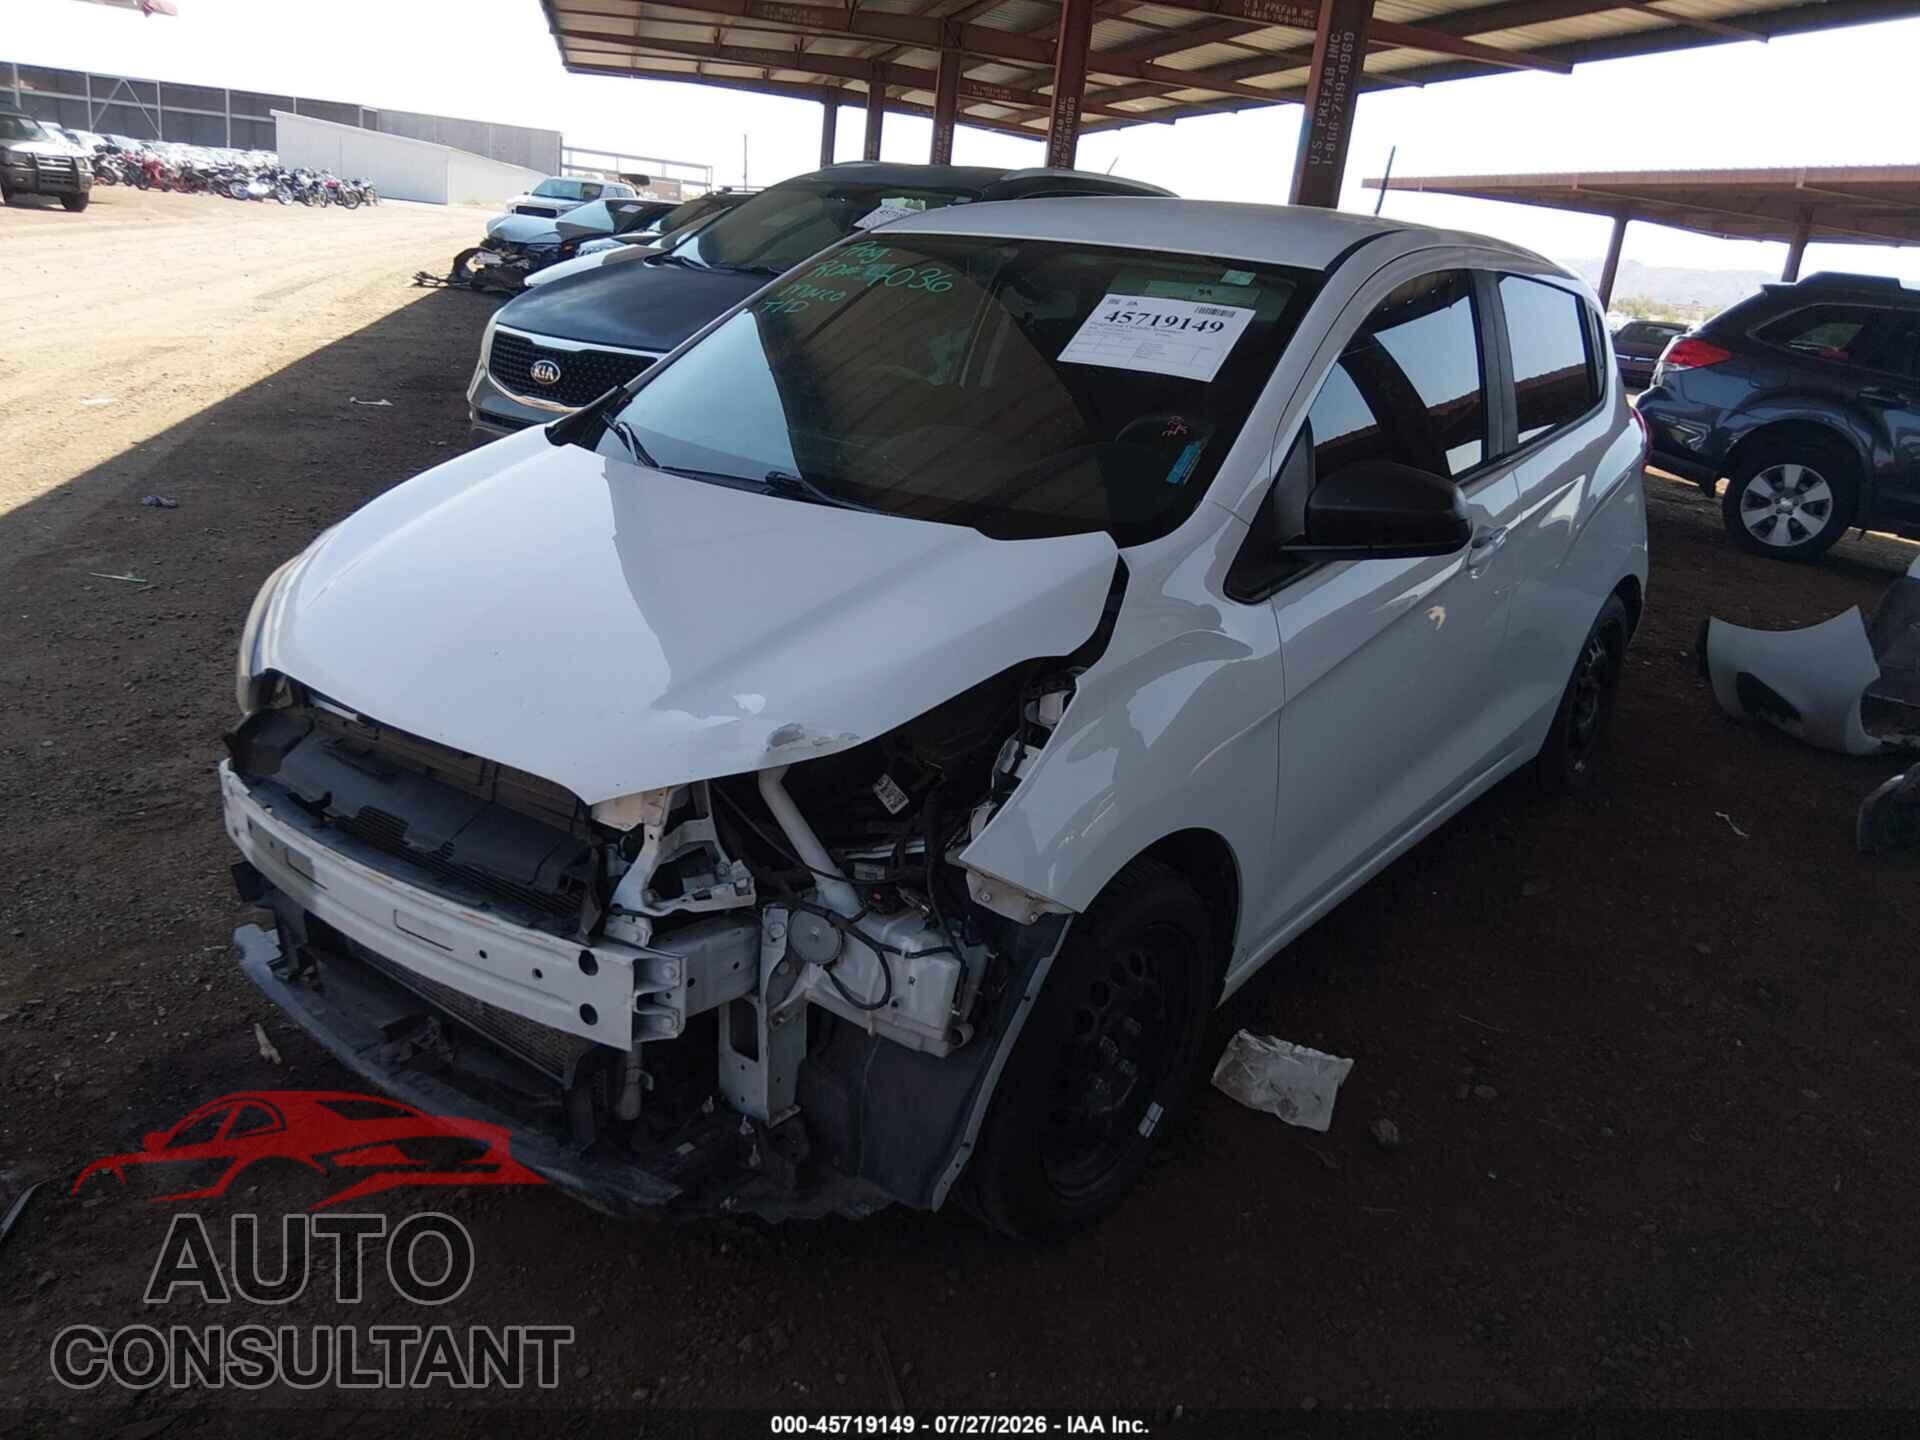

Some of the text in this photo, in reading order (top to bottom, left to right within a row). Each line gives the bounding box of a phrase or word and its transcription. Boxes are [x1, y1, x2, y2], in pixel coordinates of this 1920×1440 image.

[1315, 66, 1337, 128] PREFAB
[1104, 309, 1225, 335] 45719149
[533, 364, 555, 380] KIA
